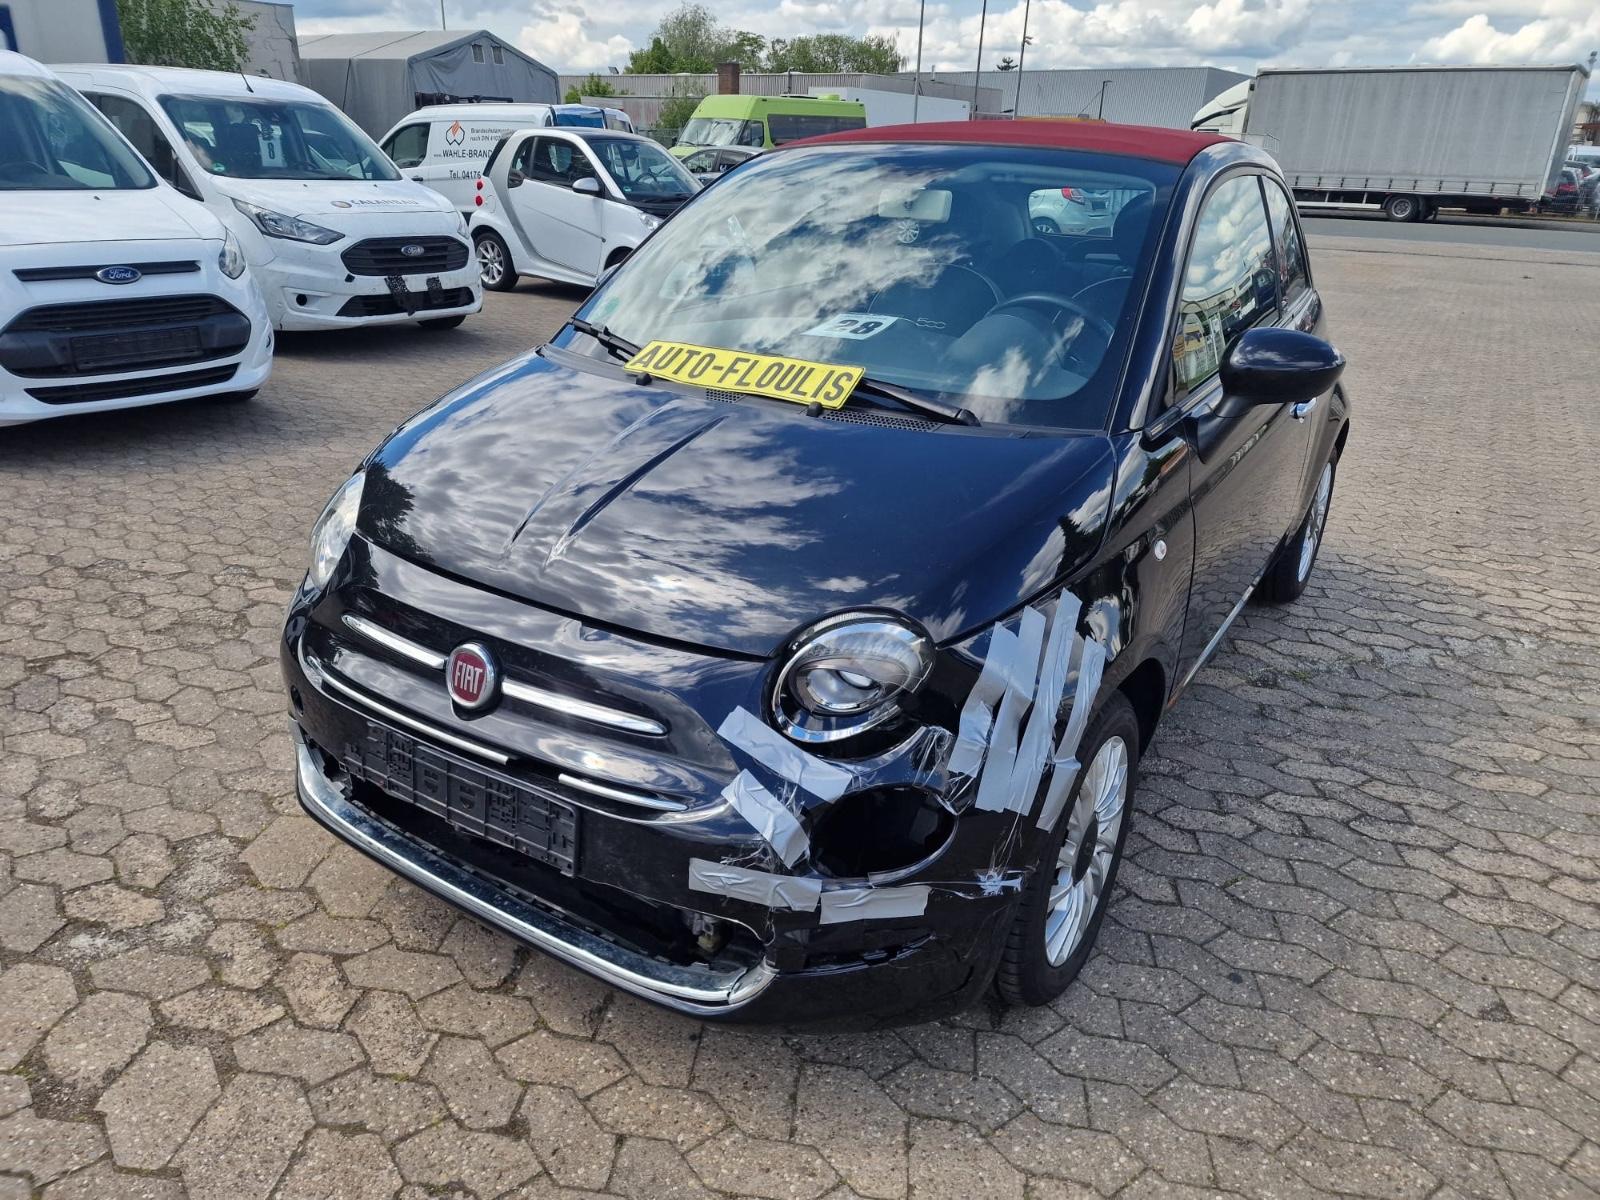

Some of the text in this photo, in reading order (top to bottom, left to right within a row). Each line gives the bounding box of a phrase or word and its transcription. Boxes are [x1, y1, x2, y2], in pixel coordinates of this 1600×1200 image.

[827, 319, 884, 335] 28
[631, 344, 854, 402] AUTO-FLOULIS
[454, 660, 484, 695] FIAT
